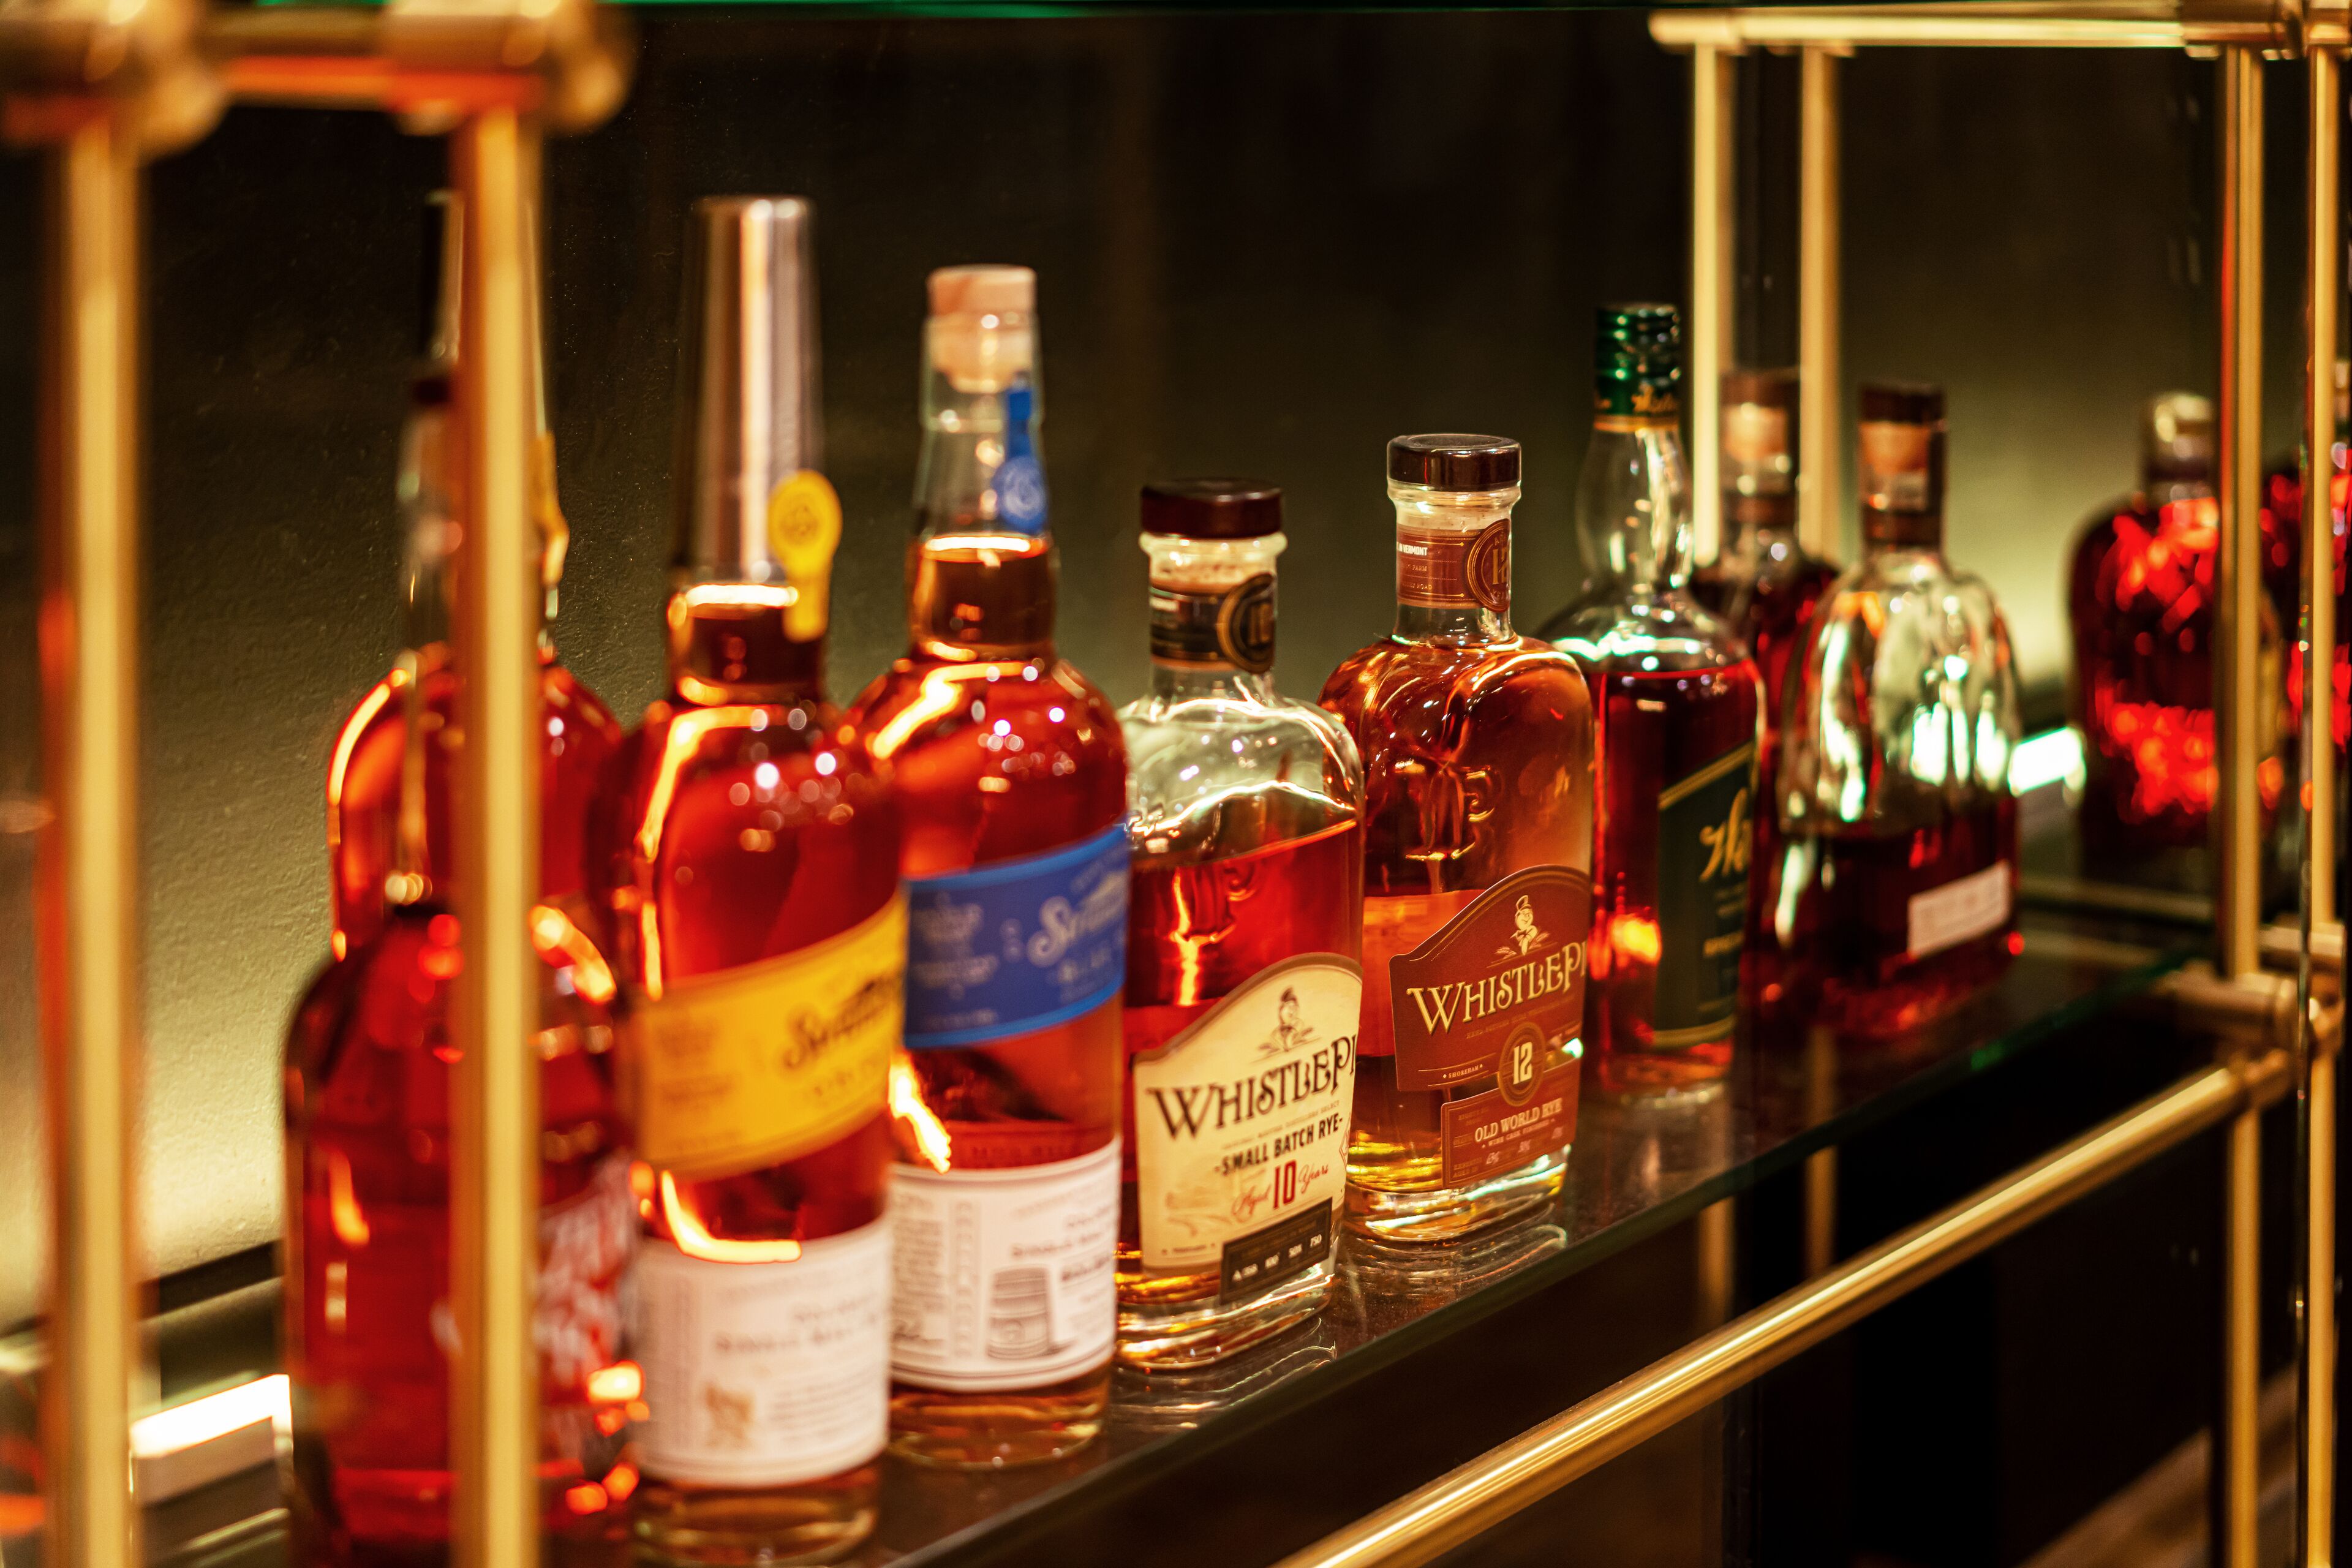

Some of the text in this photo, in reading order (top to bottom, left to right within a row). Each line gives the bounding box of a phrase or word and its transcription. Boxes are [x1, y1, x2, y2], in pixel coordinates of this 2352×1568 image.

[1403, 543, 1428, 556] VERMONT
[1447, 1065, 1479, 1079] SHOREHAM
[1512, 1041, 1533, 1085] 12
[1474, 1121, 1499, 1143] OLD
[1500, 1106, 1540, 1133] WORLD
[1542, 1097, 1563, 1118] RYE
[1273, 1123, 1314, 1158] BATCH
[1273, 1159, 1297, 1211] 10
[1297, 1164, 1329, 1194] Years
